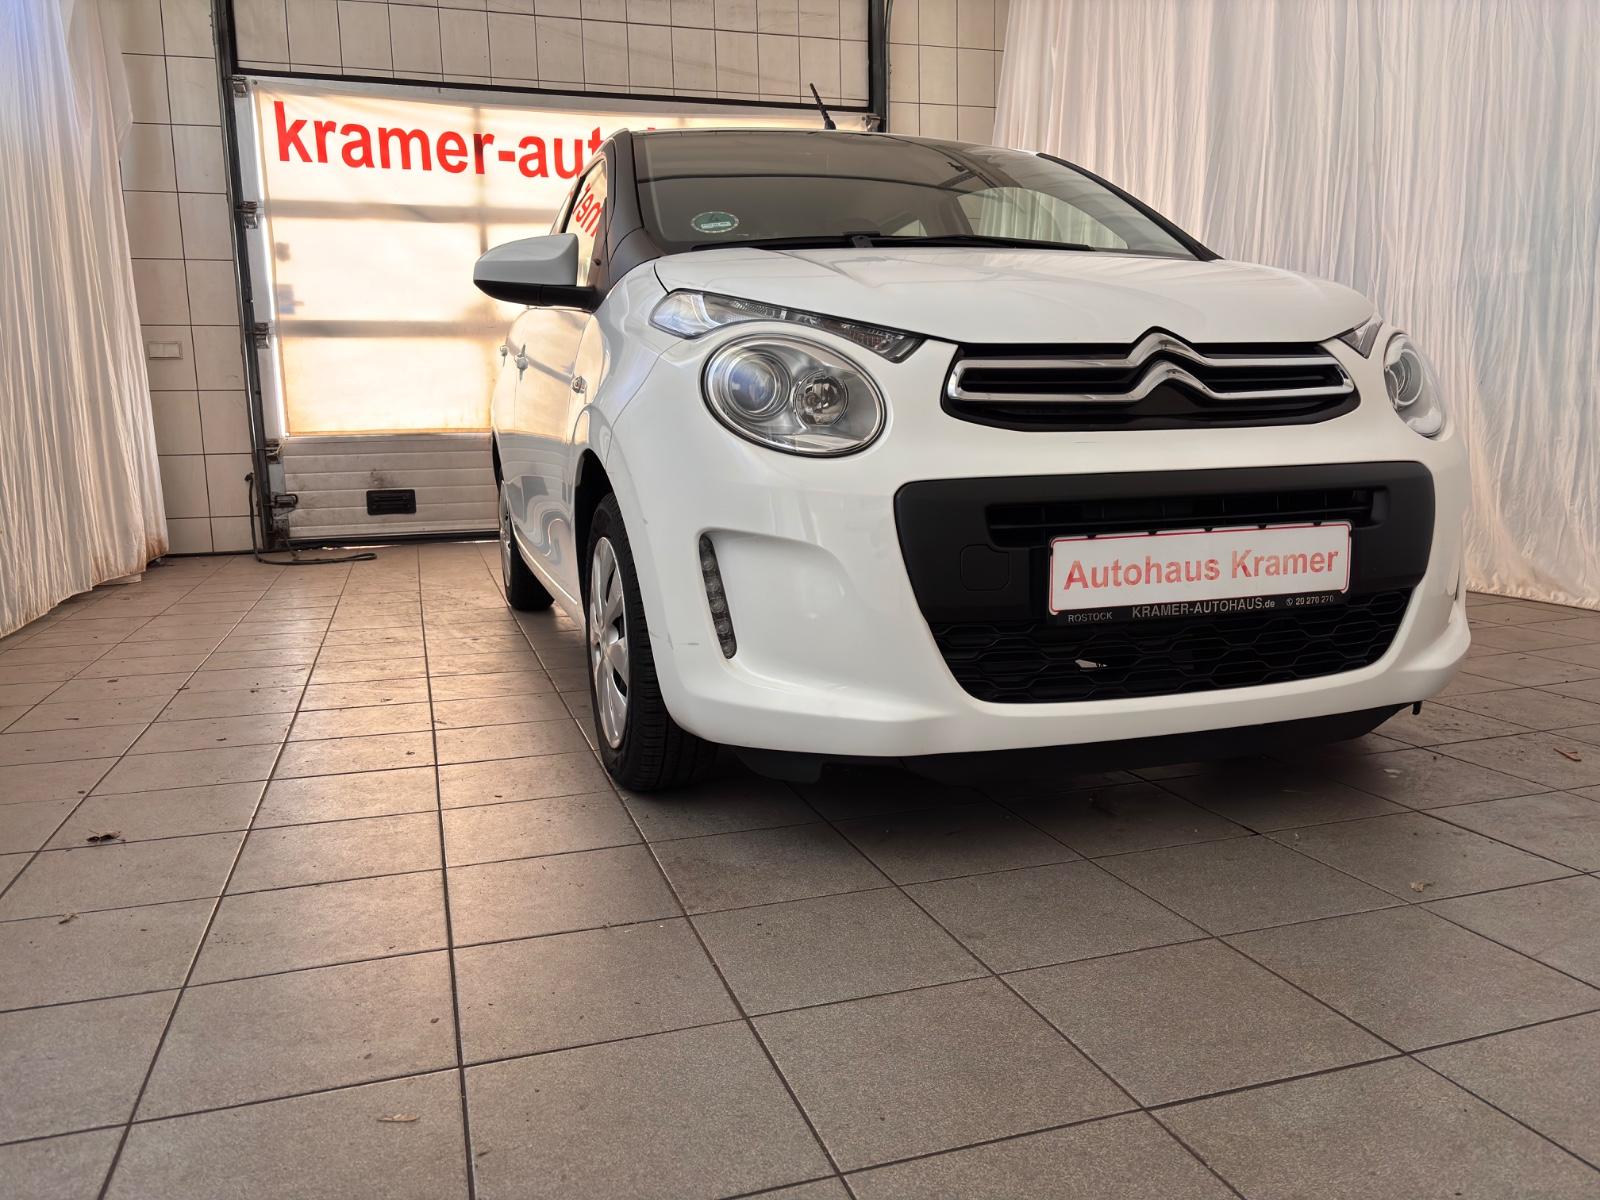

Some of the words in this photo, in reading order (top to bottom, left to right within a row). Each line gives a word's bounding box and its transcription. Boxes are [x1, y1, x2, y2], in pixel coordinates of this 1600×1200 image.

[273, 101, 604, 179] kramer-aut
[1063, 556, 1220, 590] Autohaus
[1231, 550, 1339, 579] Kramer
[1068, 611, 1113, 624] ROSTOCK
[1132, 597, 1275, 618] KRAMER-AUTOHAUS.de
